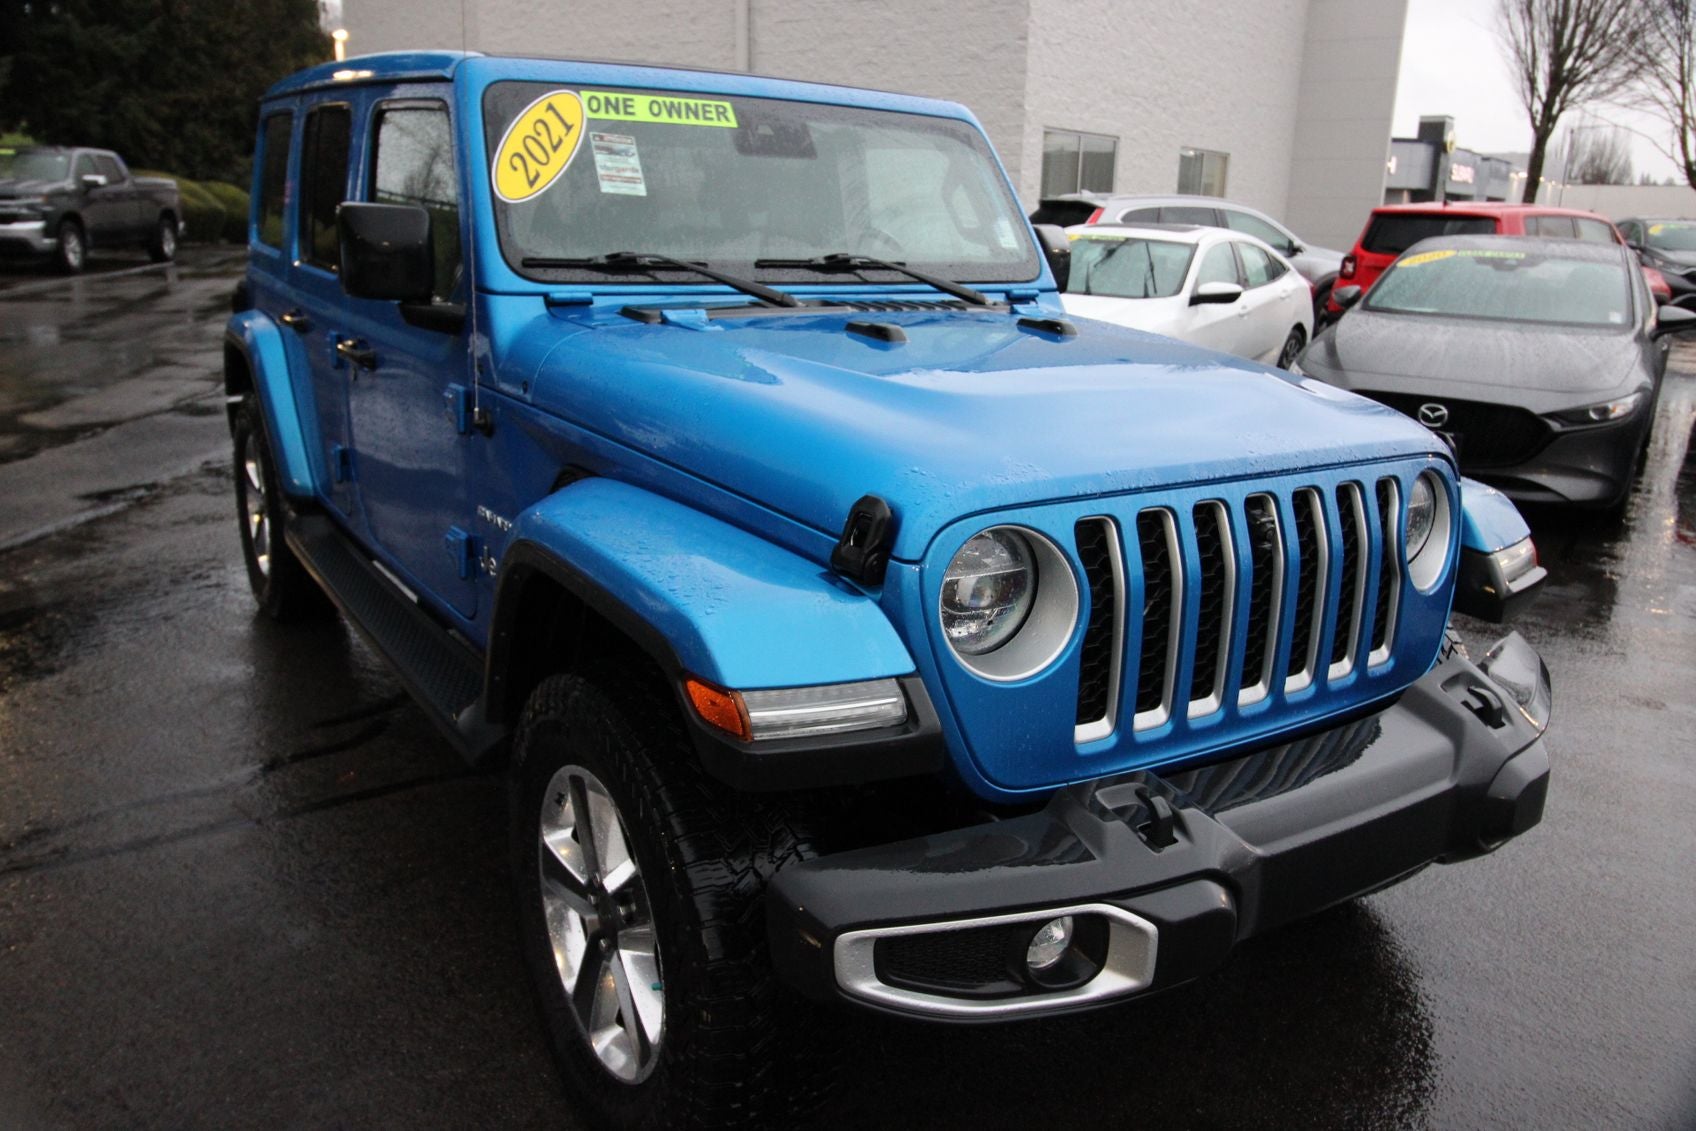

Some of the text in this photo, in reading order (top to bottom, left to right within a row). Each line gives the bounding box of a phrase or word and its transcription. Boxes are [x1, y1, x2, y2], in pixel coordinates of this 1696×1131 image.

[587, 95, 731, 123] ONE OWNER
[509, 102, 574, 189] 2021
